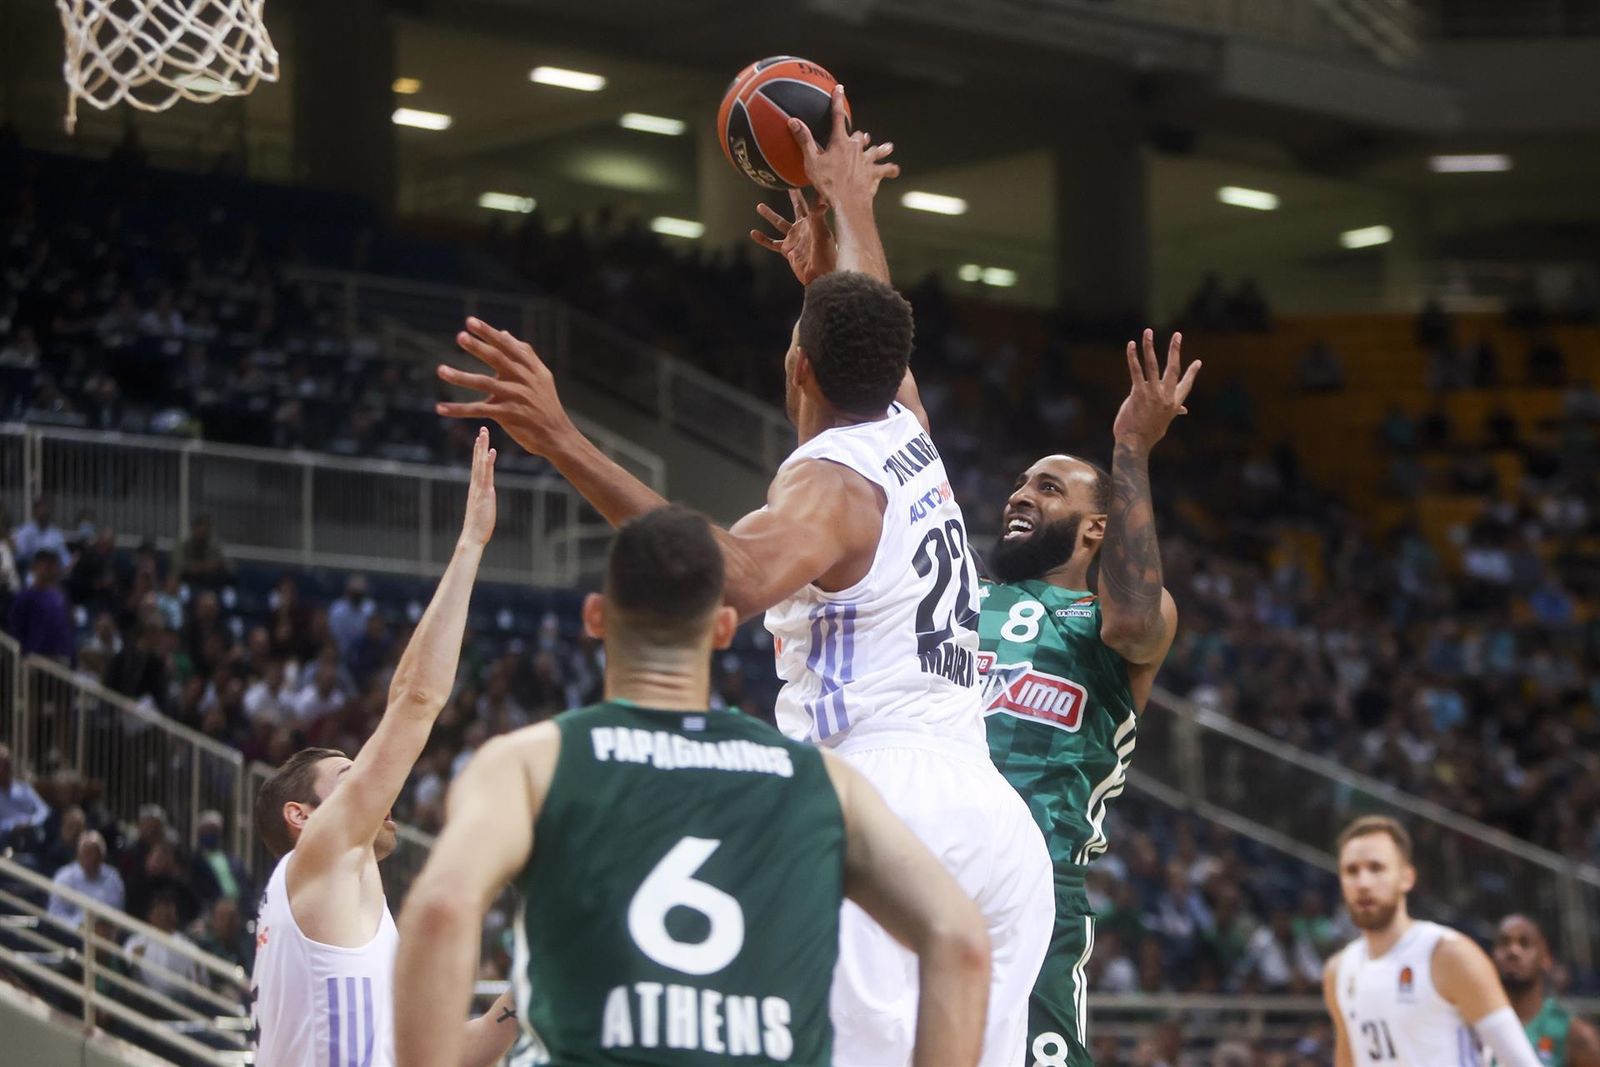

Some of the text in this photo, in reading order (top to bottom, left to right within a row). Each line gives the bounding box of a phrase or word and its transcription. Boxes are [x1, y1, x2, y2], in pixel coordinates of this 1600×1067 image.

[1000, 600, 1045, 643] 8
[591, 726, 794, 778] PAPAGIANNIS
[627, 835, 745, 976] 6
[601, 981, 794, 1061] ATHENS
[1361, 1018, 1397, 1062] 31
